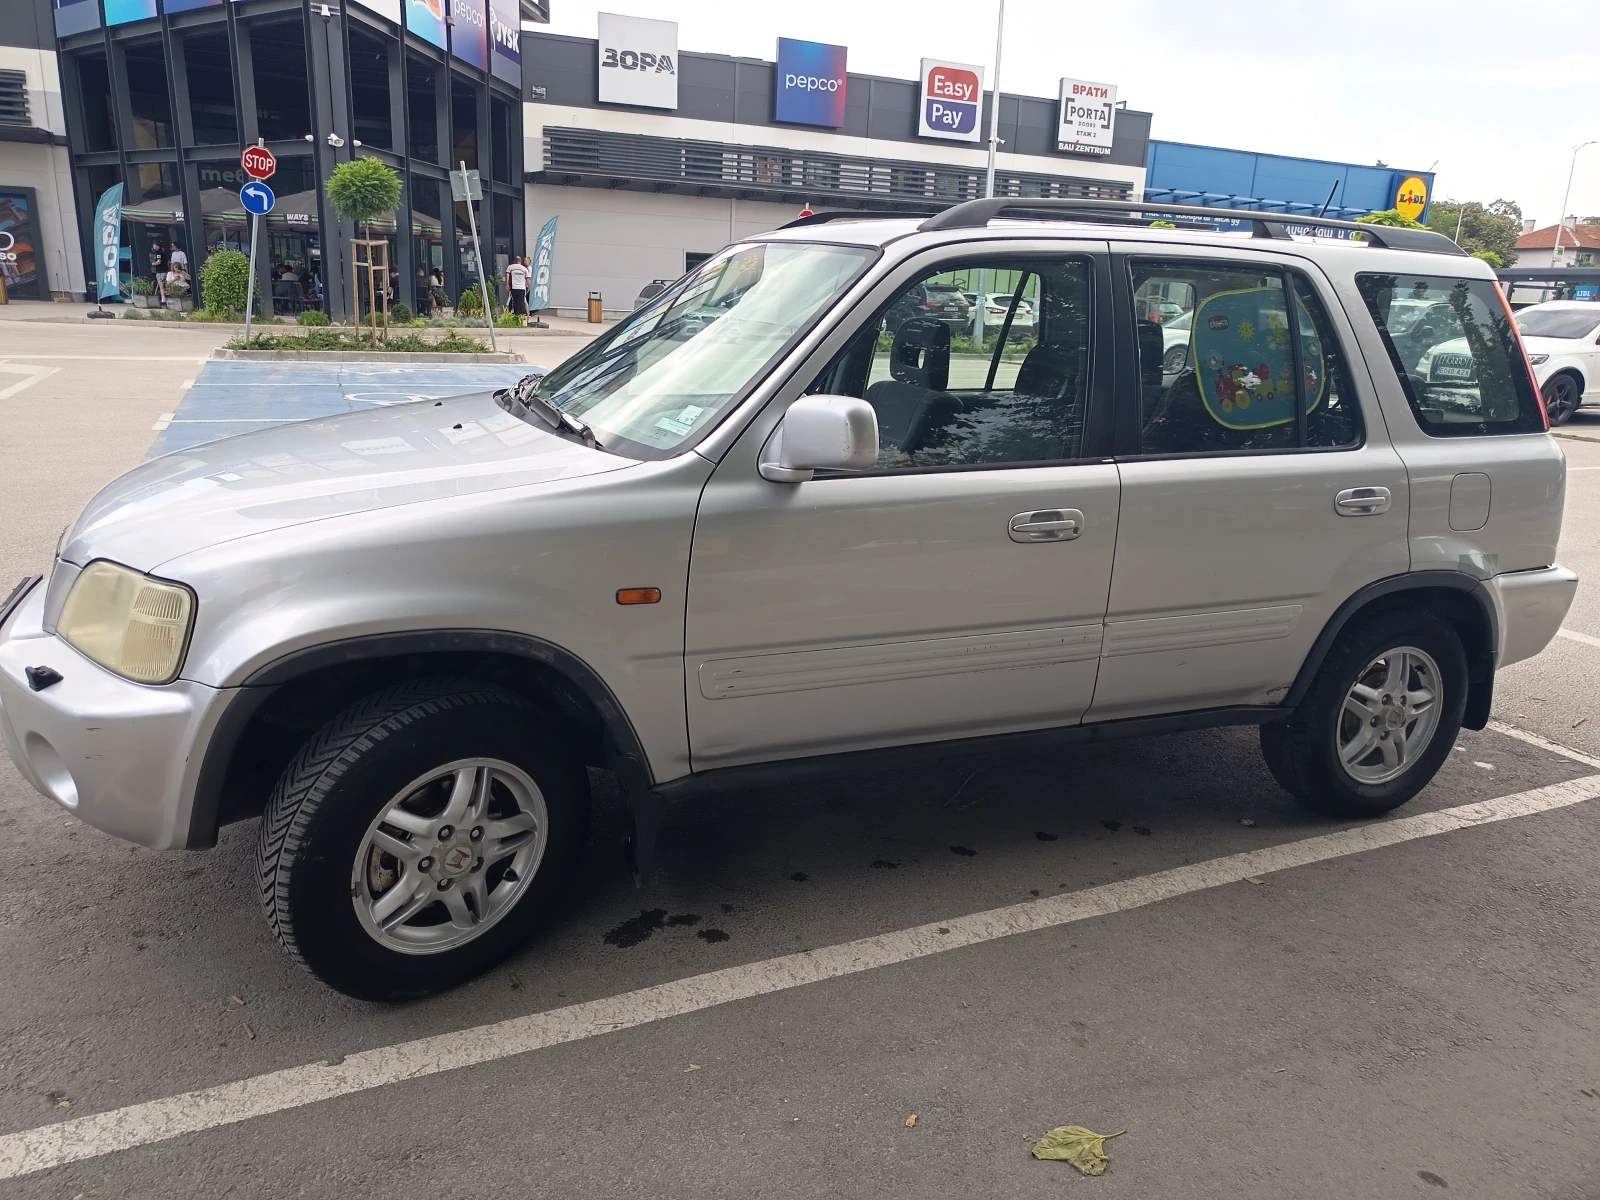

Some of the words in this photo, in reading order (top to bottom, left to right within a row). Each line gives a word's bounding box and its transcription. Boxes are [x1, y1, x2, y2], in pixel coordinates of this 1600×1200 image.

[454, 0, 483, 28] pepco
[496, 21, 520, 54] JYSK
[601, 47, 676, 75] ЗОРА
[933, 74, 974, 101] Easy
[1072, 84, 1108, 99] ВРАТИ
[931, 103, 963, 129] Pay
[1069, 105, 1107, 121] PORTA
[245, 153, 274, 172] STOP
[286, 213, 309, 222] WAYS
[102, 203, 120, 287] ЗОРА
[534, 231, 555, 302] ЗОРА
